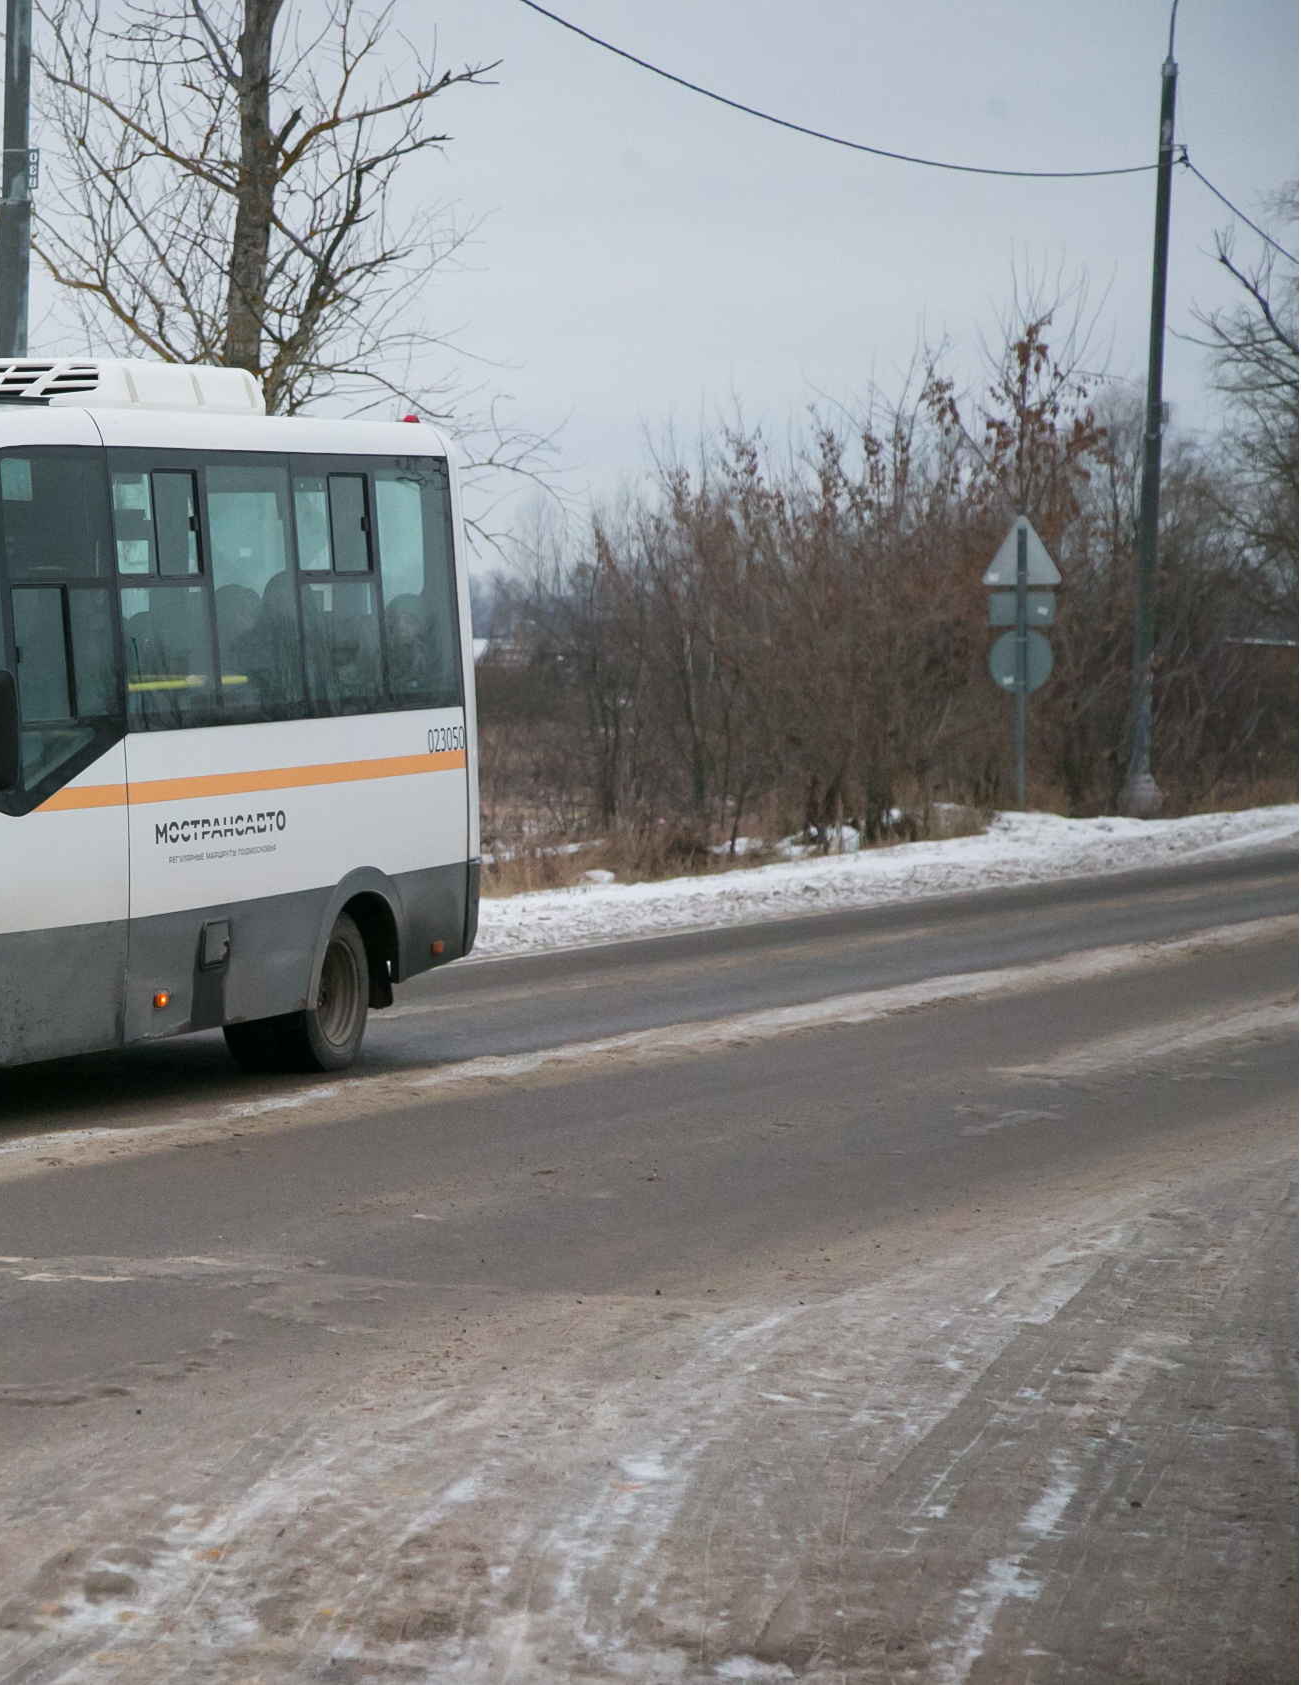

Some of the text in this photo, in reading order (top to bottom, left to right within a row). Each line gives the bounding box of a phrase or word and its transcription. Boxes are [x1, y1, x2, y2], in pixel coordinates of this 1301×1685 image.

[427, 725, 465, 753] 023050
[155, 810, 286, 844] МОСТРАНСАВТО
[168, 844, 277, 864] РЕГУЛЯРНЫЕ МАРШРУТЫ ПОДМОСКОВЬЯ
